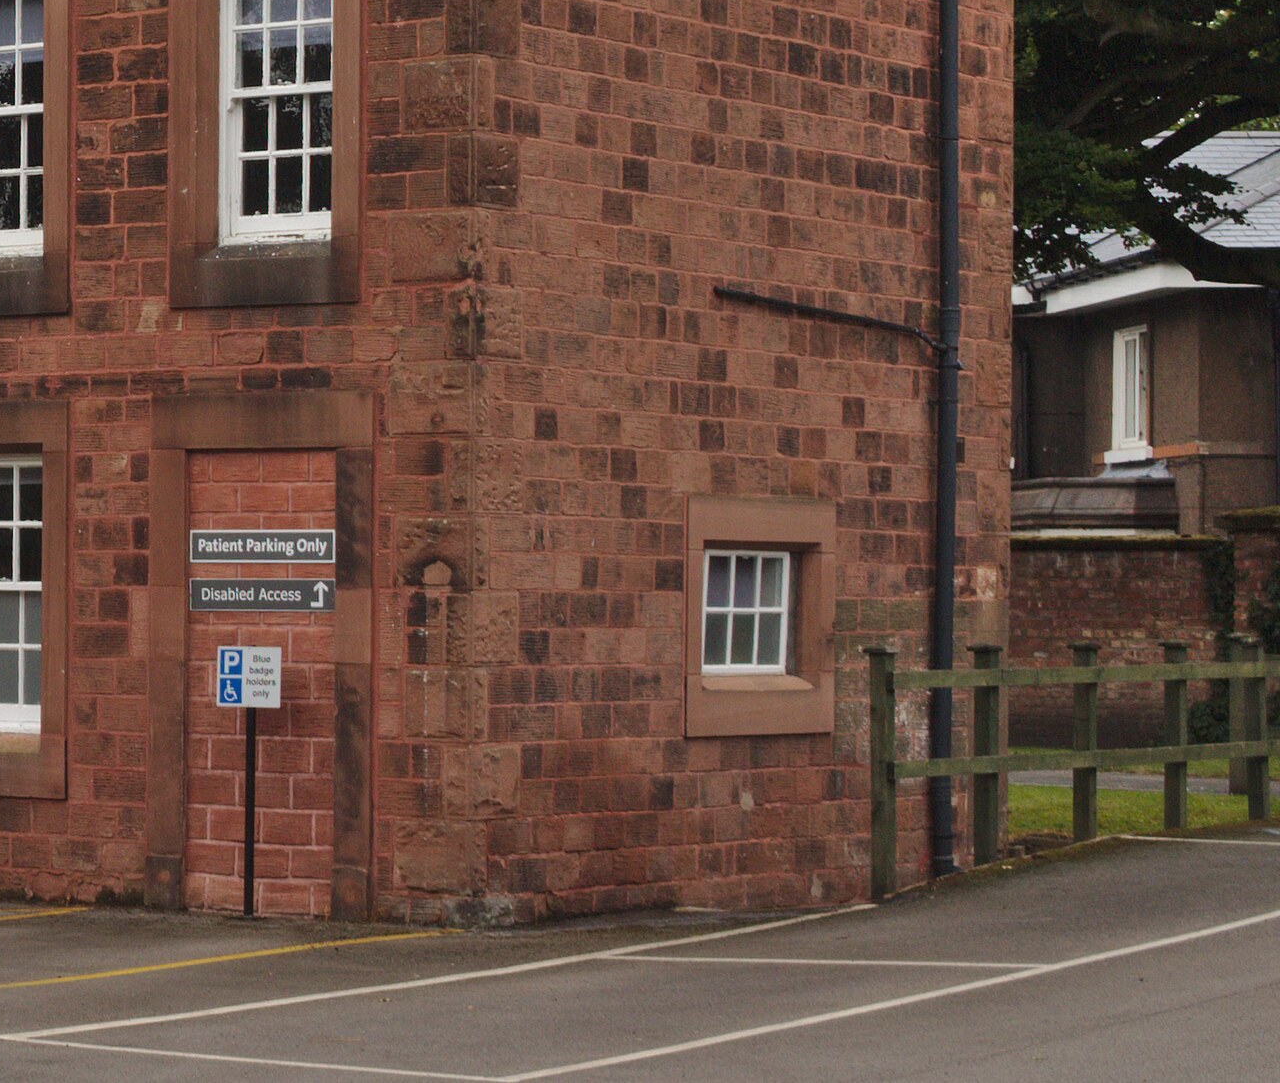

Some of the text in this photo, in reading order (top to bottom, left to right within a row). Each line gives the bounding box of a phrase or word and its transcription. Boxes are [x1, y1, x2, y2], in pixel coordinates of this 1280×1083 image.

[198, 538, 327, 556] Patient Parking Only
[201, 587, 302, 601] Disabled Access
[224, 651, 240, 674] P
[252, 654, 271, 663] Blue
[249, 666, 274, 675] badge
[246, 677, 276, 686] holders
[252, 689, 270, 699] only
